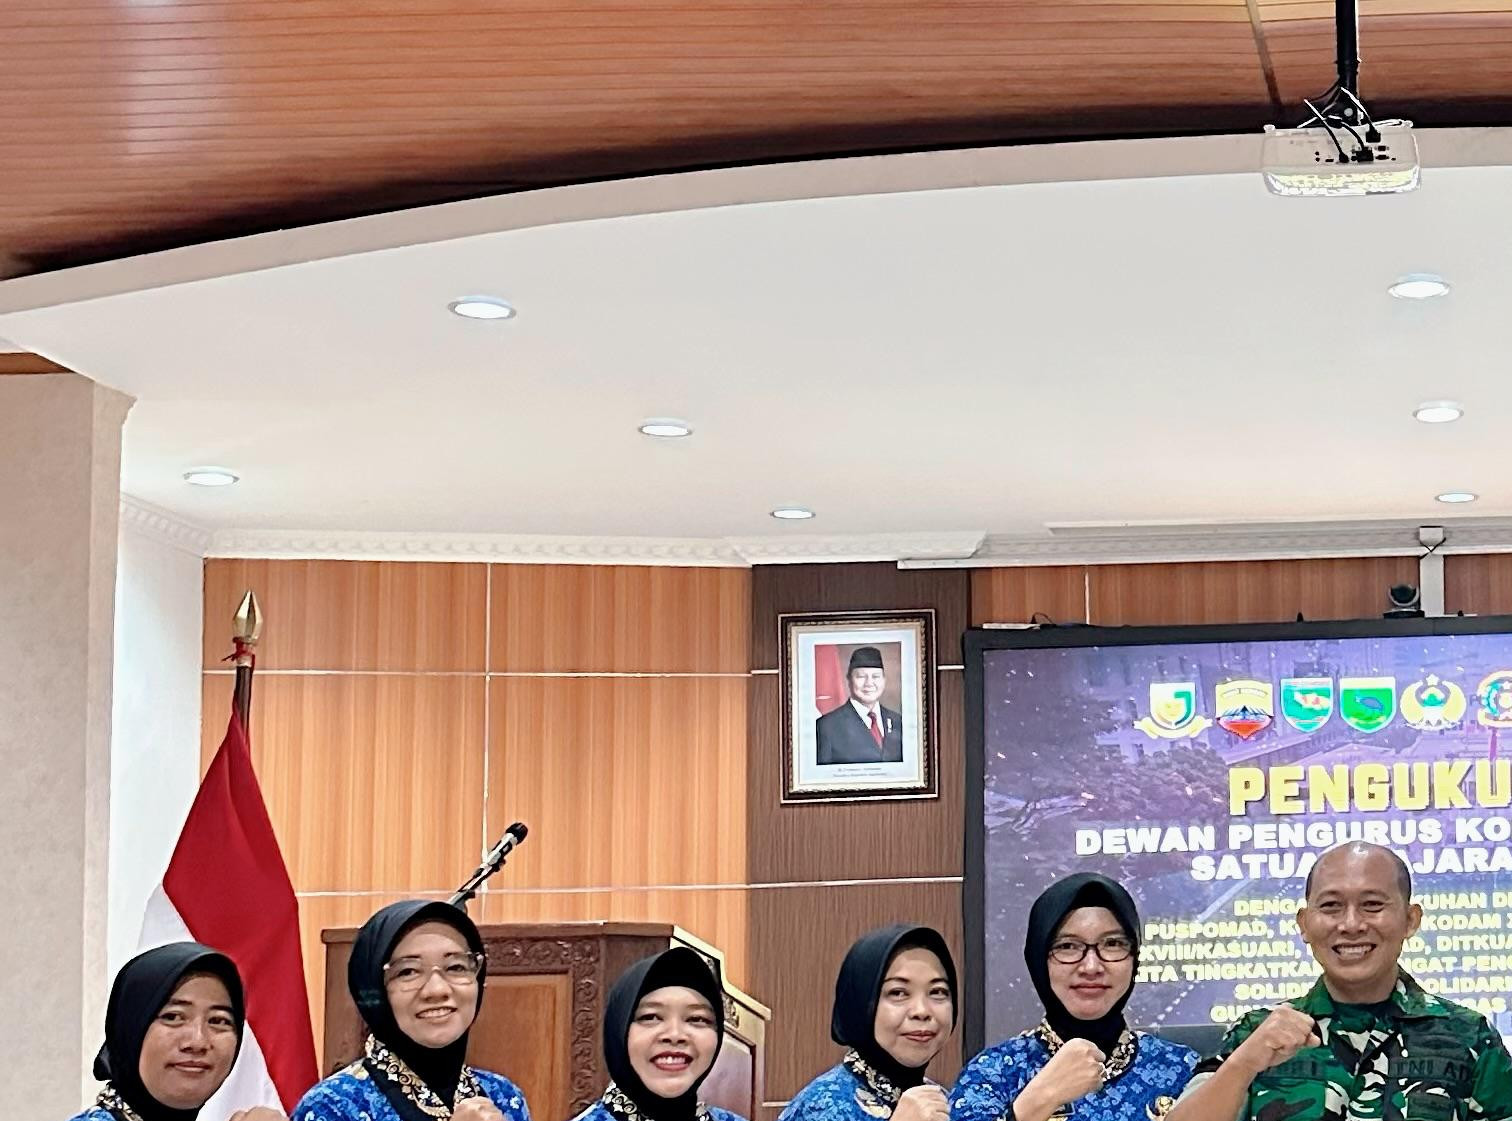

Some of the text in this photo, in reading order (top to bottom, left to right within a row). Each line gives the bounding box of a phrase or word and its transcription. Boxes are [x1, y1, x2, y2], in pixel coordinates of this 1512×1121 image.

[1075, 826, 1216, 856] DEWAN
[1228, 819, 1443, 850] PENGURUS
[1190, 851, 1317, 882] SATUA
[1144, 919, 1275, 941] PUSPOMAD,
[1421, 913, 1502, 931] KODAM
